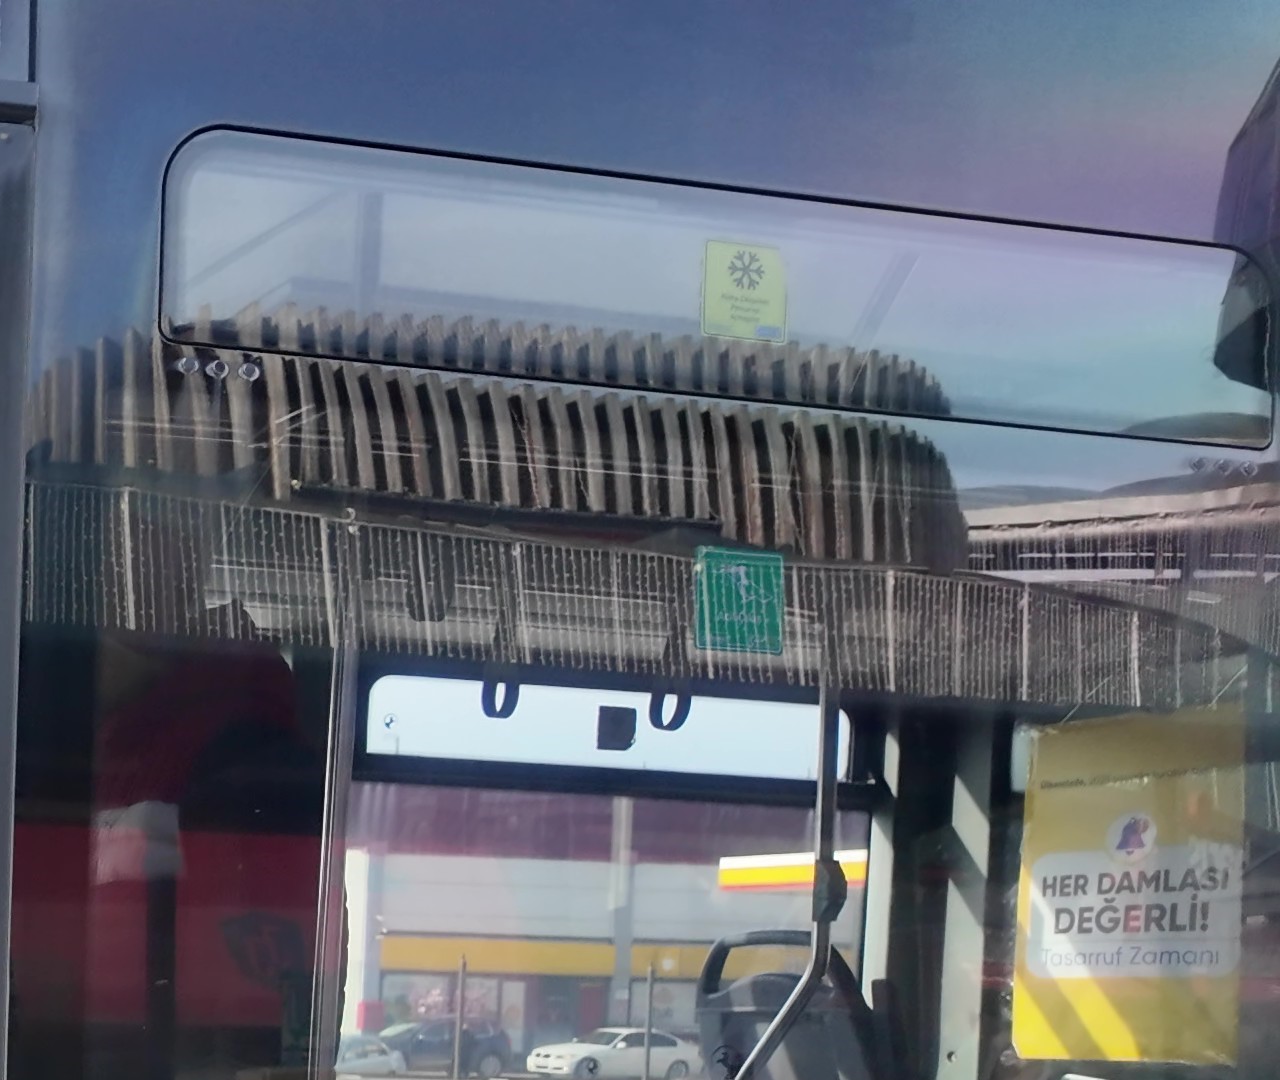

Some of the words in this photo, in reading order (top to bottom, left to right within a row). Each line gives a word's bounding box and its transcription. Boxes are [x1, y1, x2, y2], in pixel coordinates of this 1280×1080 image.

[1042, 873, 1089, 898] HER
[1096, 865, 1230, 896] DAMLASI
[1053, 893, 1210, 935] DEĞERLİ!
[1042, 945, 1124, 968] Tasarruf
[1128, 946, 1220, 967] Zamanı
